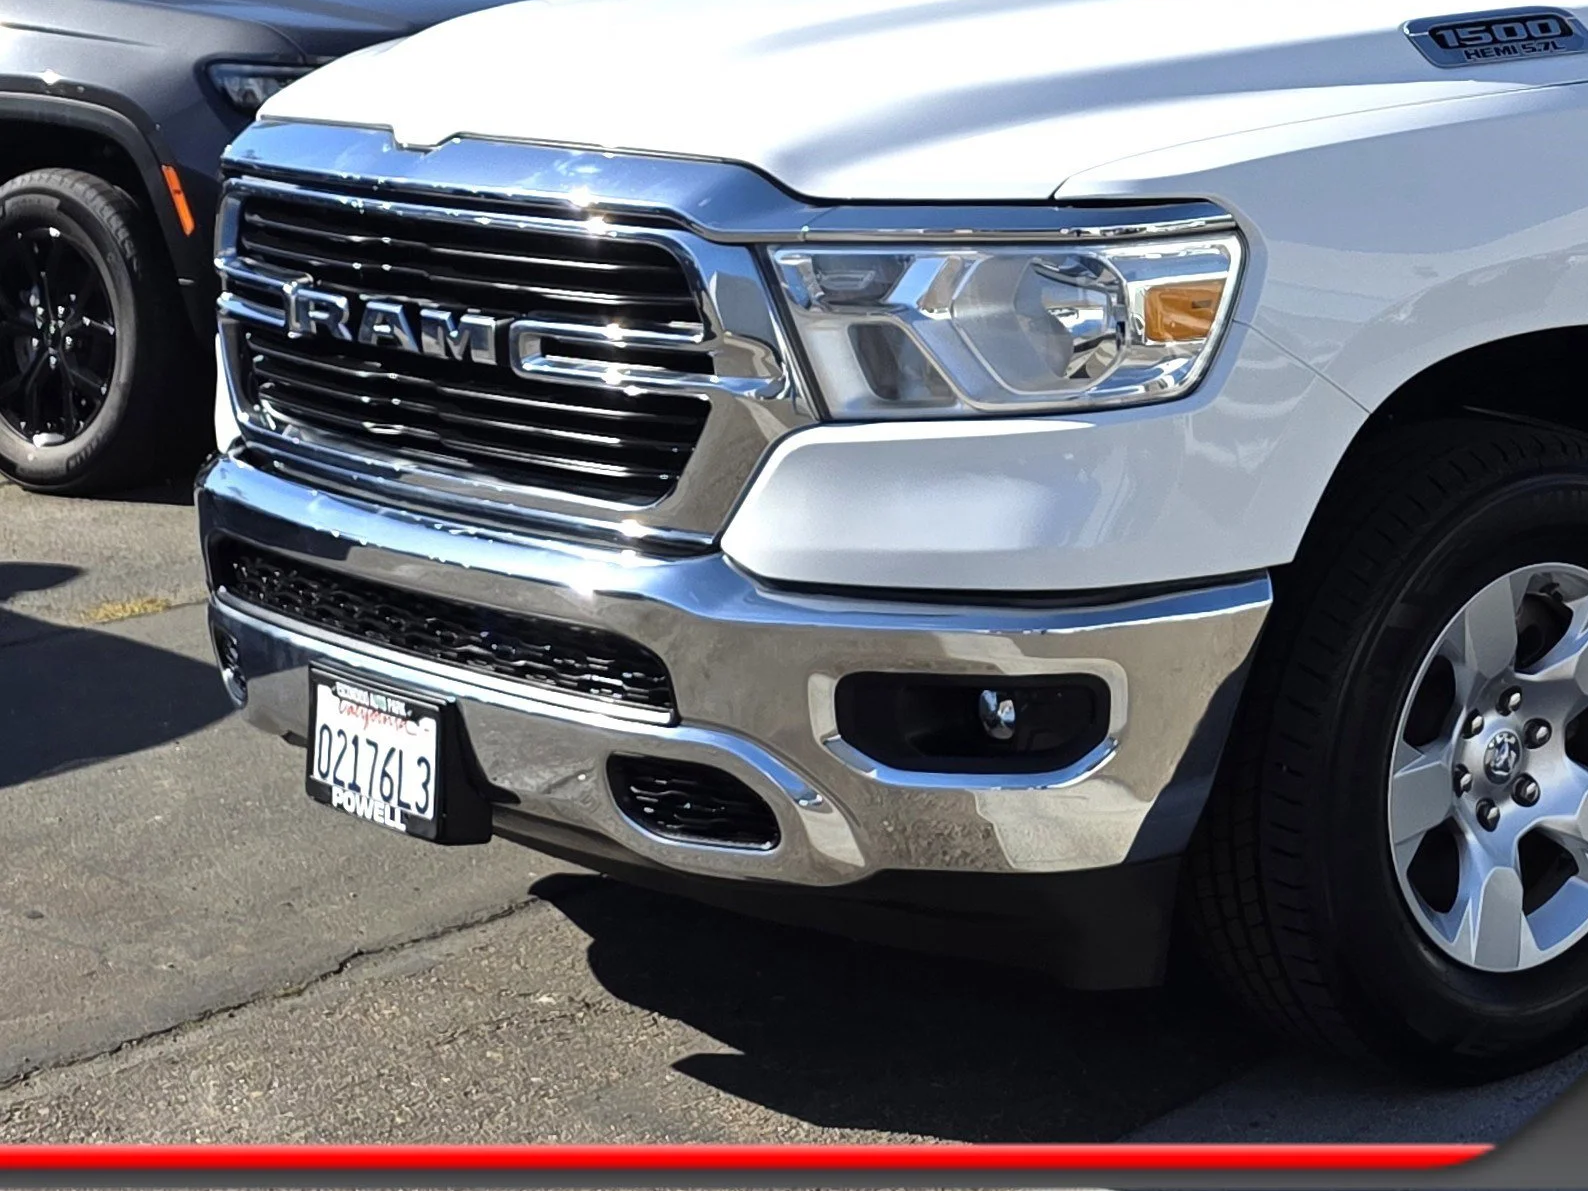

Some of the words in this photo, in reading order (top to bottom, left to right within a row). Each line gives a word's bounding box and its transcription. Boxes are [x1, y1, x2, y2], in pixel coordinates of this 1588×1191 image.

[1437, 19, 1563, 47] 1500
[1463, 43, 1518, 61] HEMI
[1522, 39, 1566, 54] 5.7L
[286, 283, 504, 365] RAM
[317, 723, 431, 814] 02176L3
[332, 786, 406, 832] POWELL
